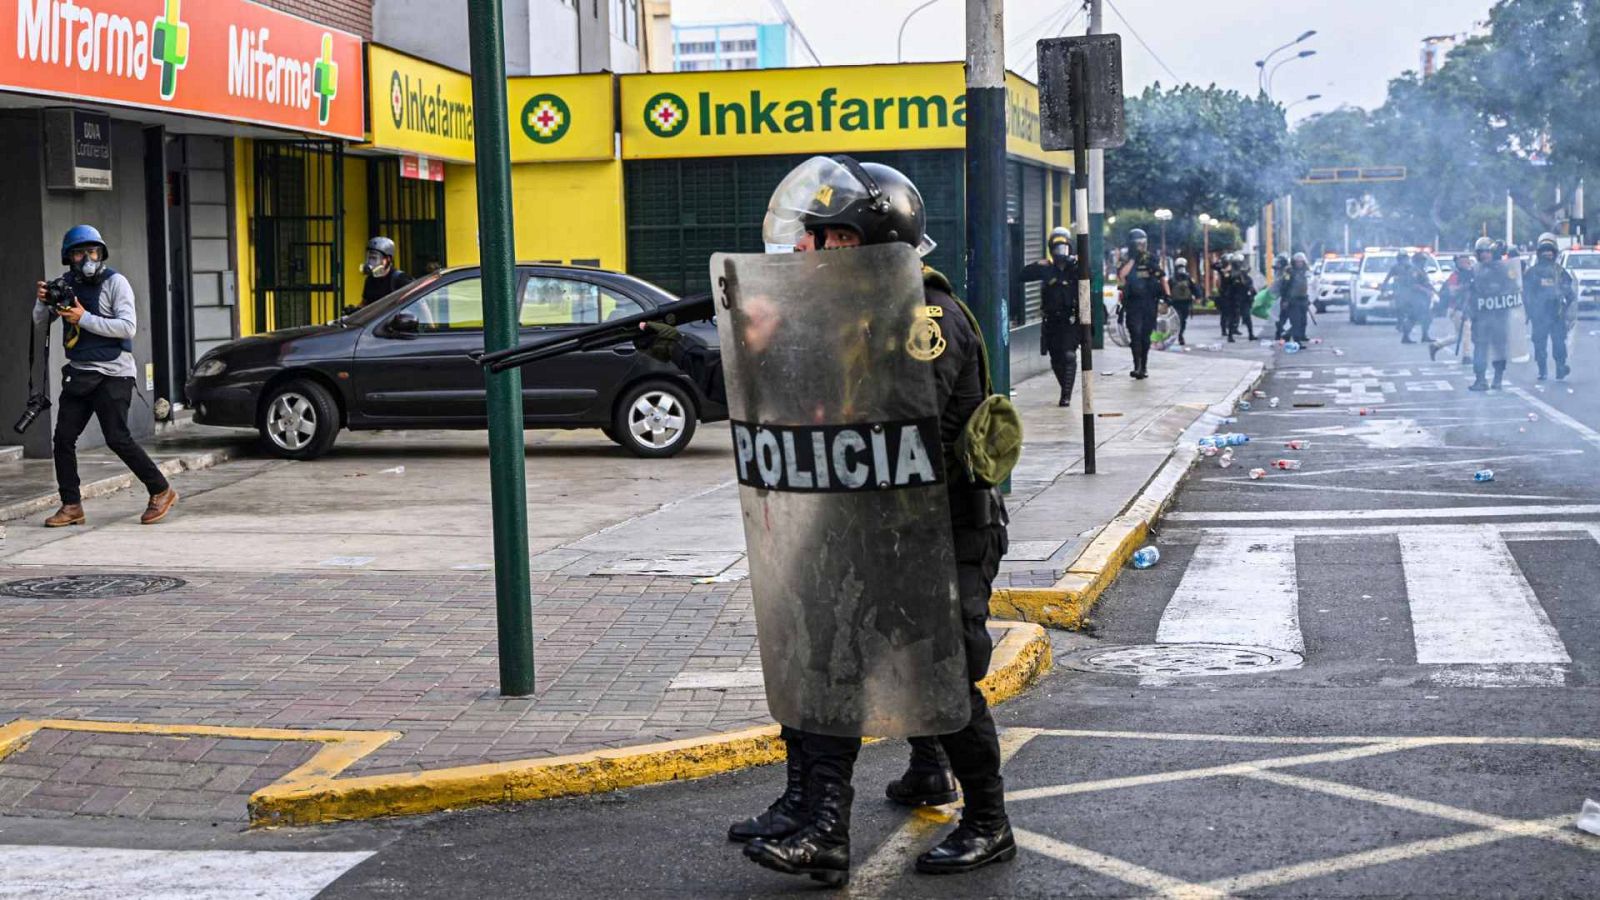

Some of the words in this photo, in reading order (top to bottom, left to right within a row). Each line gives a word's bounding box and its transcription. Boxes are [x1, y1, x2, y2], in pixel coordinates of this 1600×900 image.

[228, 24, 311, 110] Mifarma
[405, 74, 473, 141] Inkafarma
[718, 275, 732, 310] 3
[1477, 293, 1523, 310] POLICIA
[734, 424, 937, 489] POLICIA
